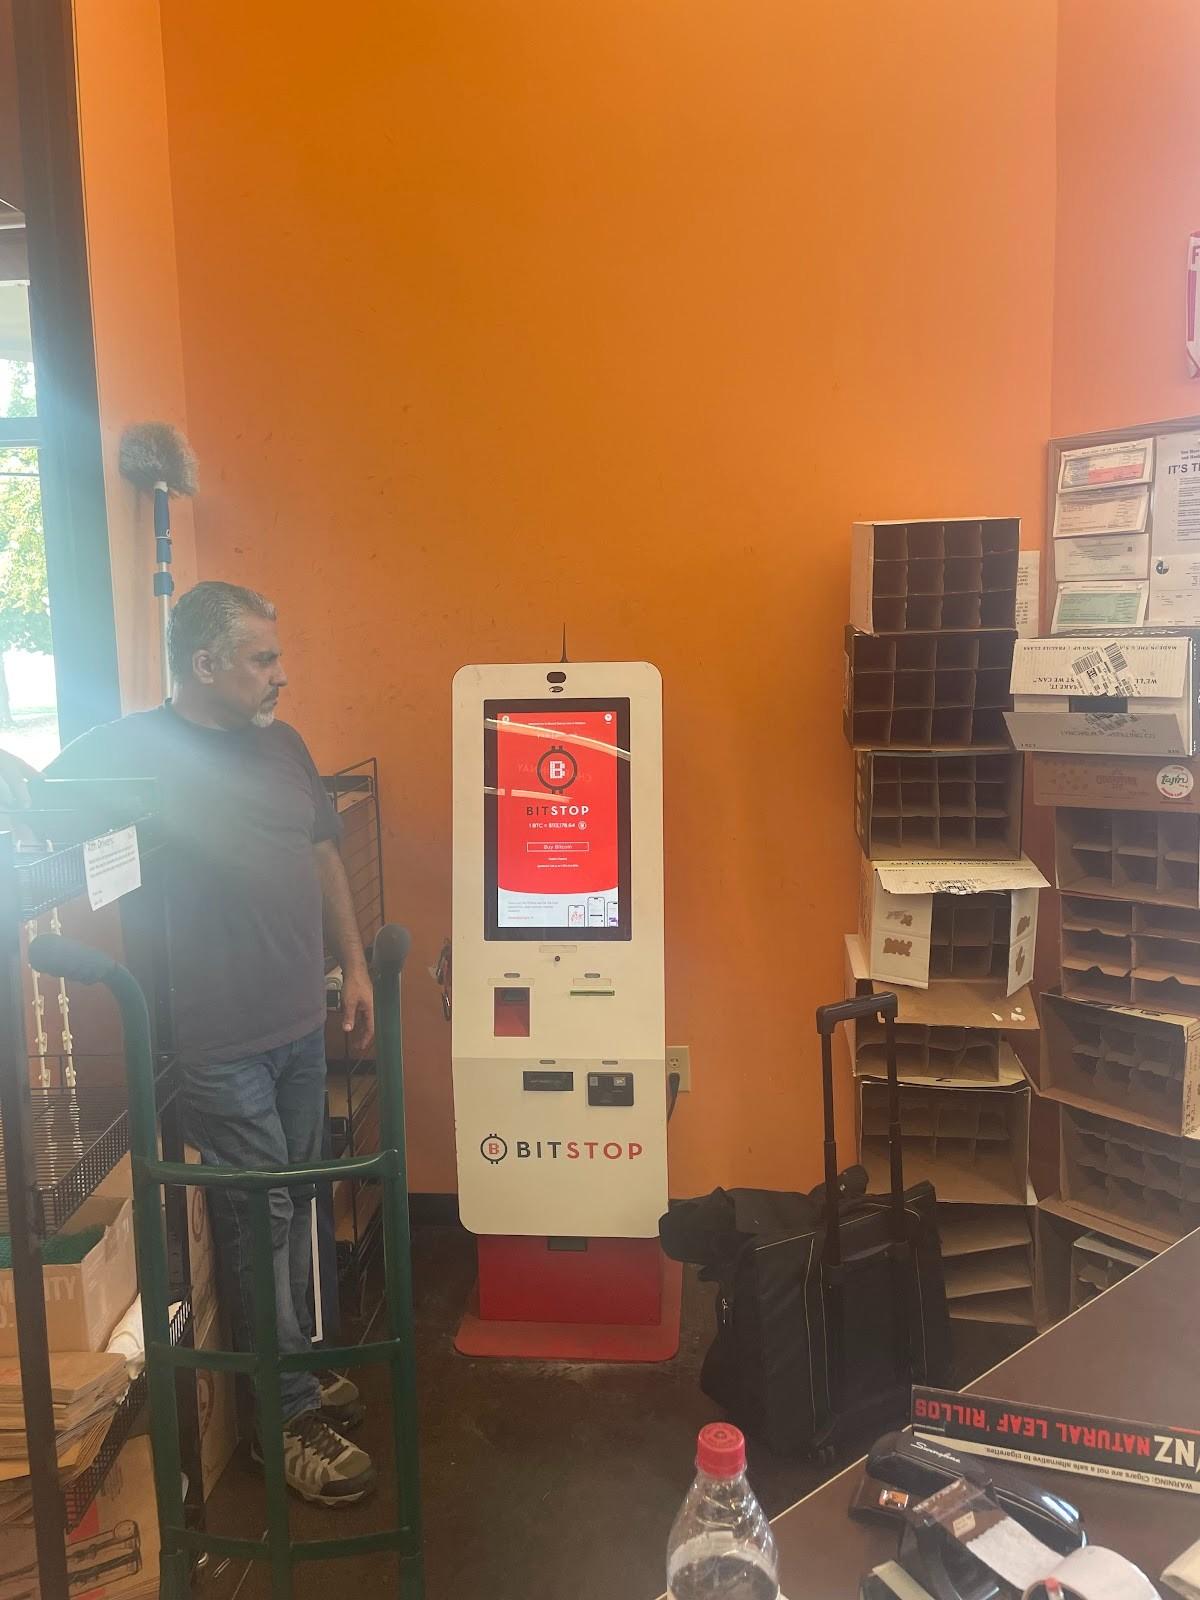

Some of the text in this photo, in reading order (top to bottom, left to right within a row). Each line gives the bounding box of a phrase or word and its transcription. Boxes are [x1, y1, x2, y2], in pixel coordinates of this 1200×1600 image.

[1168, 463, 1188, 475] IT'S
[526, 805, 590, 816] BITSTOP
[516, 1141, 643, 1160] BITSTOP
[915, 1398, 1200, 1475] NZ NATURAL LEAF 'RILLOS
[984, 1447, 1022, 1460] cigarettes.
[1032, 1456, 1072, 1468] alternative
[1072, 1461, 1089, 1471] safe
[1096, 1466, 1110, 1475] not
[1111, 1469, 1124, 1477] are
[1124, 1471, 1151, 1484] Cigars
[1151, 1476, 1194, 1490] WARNING:
